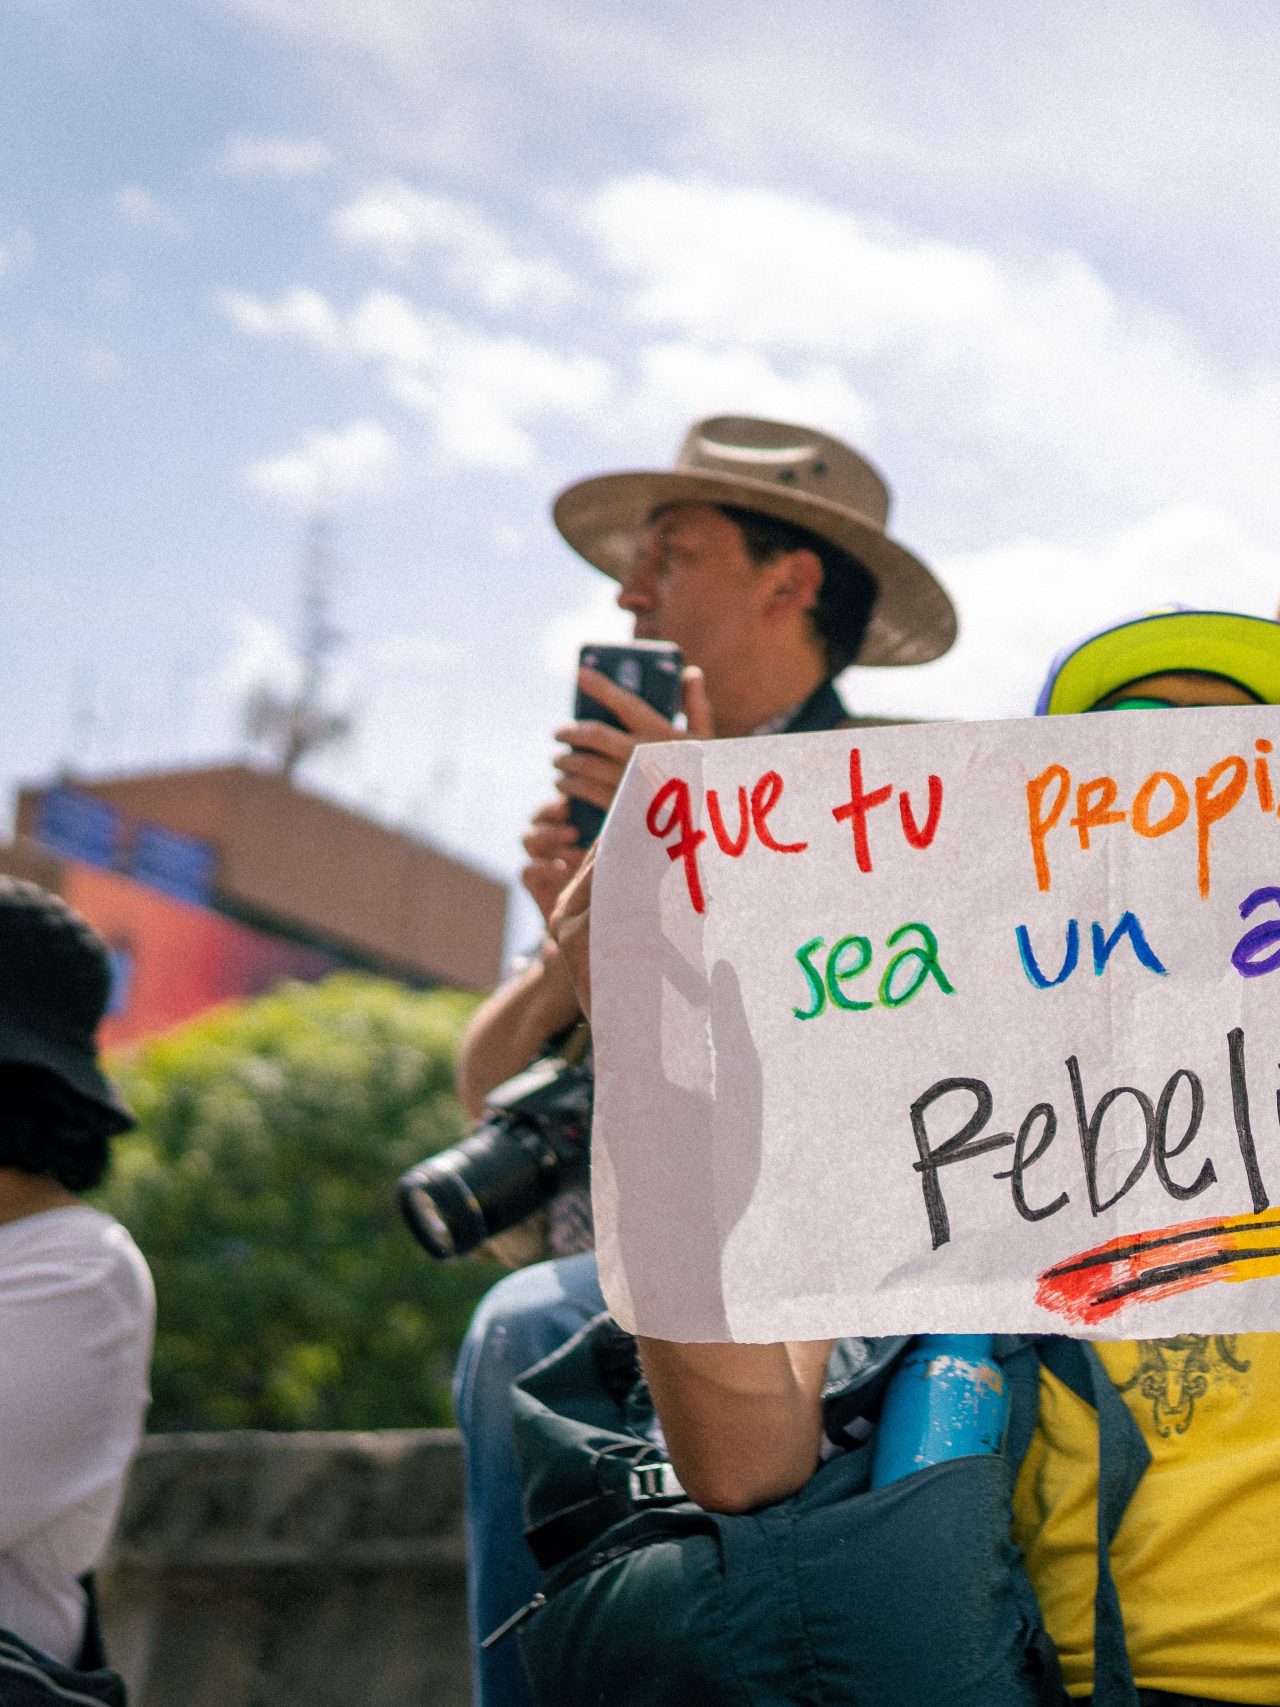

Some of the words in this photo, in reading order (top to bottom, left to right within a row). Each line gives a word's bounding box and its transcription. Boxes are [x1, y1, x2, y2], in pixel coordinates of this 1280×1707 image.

[646, 770, 809, 914] que
[832, 748, 943, 873] tu
[793, 921, 956, 1020] sea
[1015, 910, 1169, 990] un
